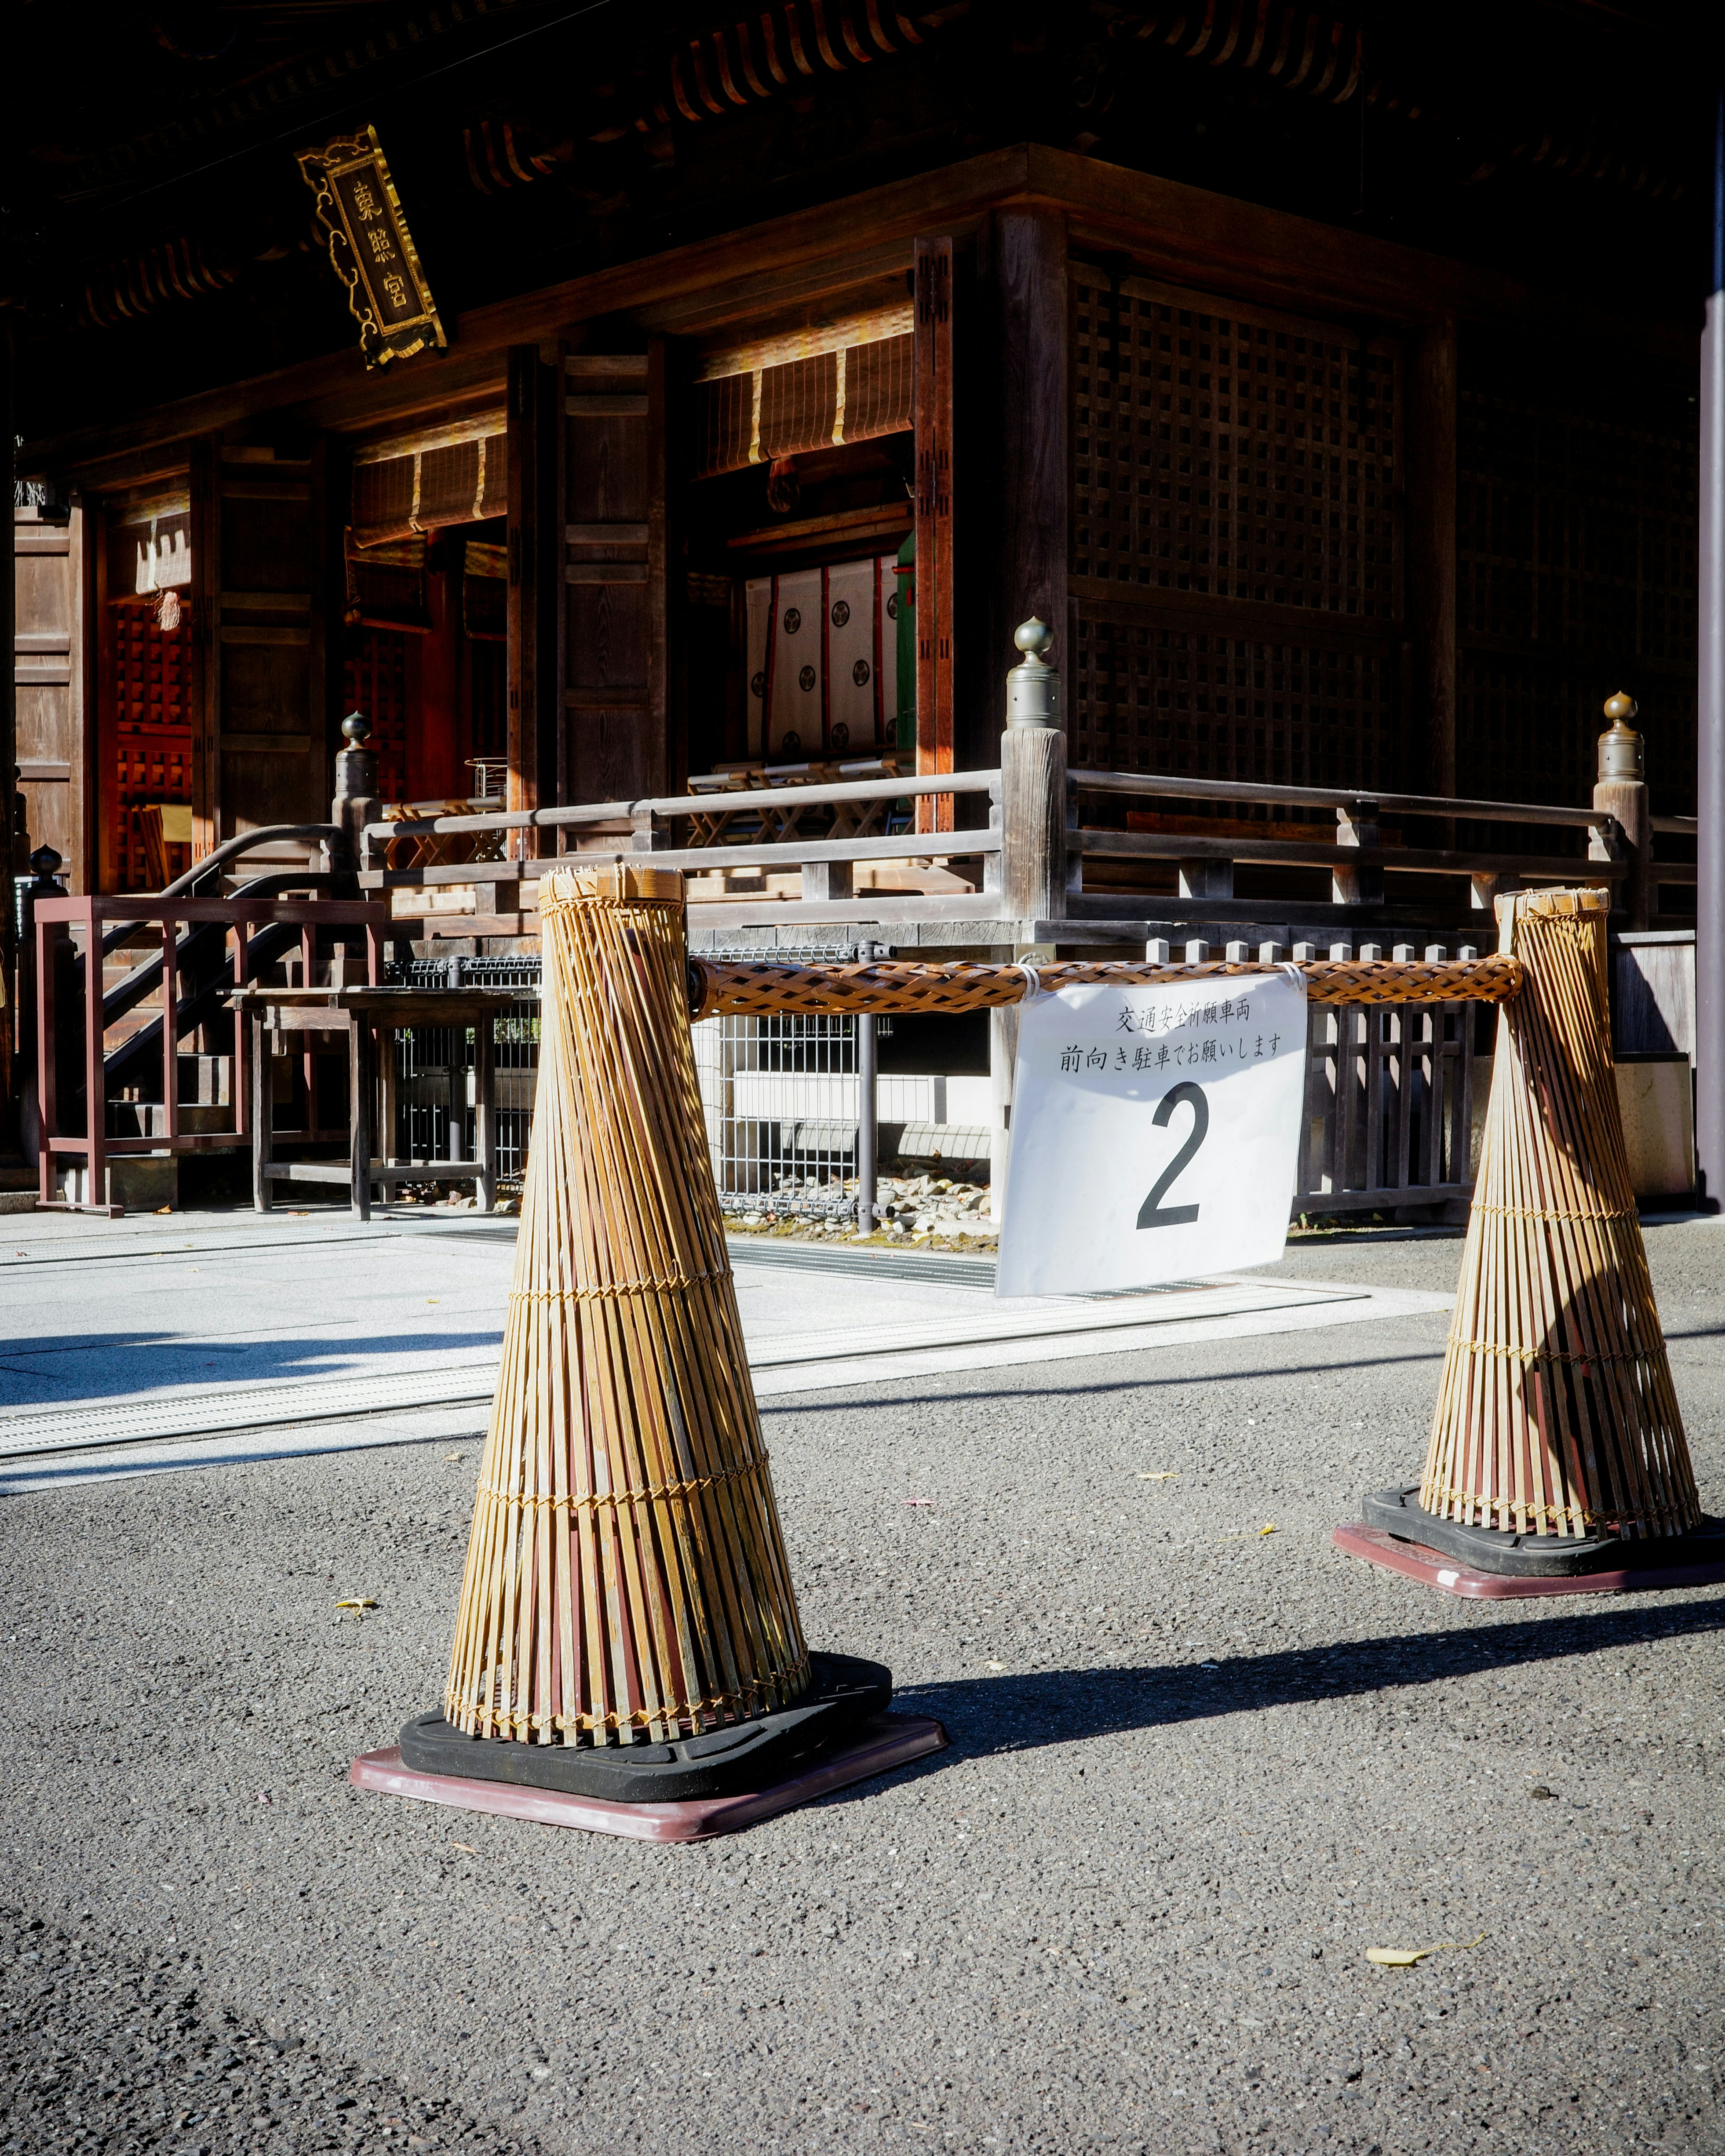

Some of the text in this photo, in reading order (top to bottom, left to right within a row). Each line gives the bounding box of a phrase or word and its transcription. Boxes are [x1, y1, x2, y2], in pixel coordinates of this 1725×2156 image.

[354, 181, 406, 308] 東照宮
[1061, 1033, 1280, 1073] 前向き駐車でお願いします
[1116, 998, 1250, 1032] 交通安全祈願車両
[1136, 1081, 1209, 1230] 2
